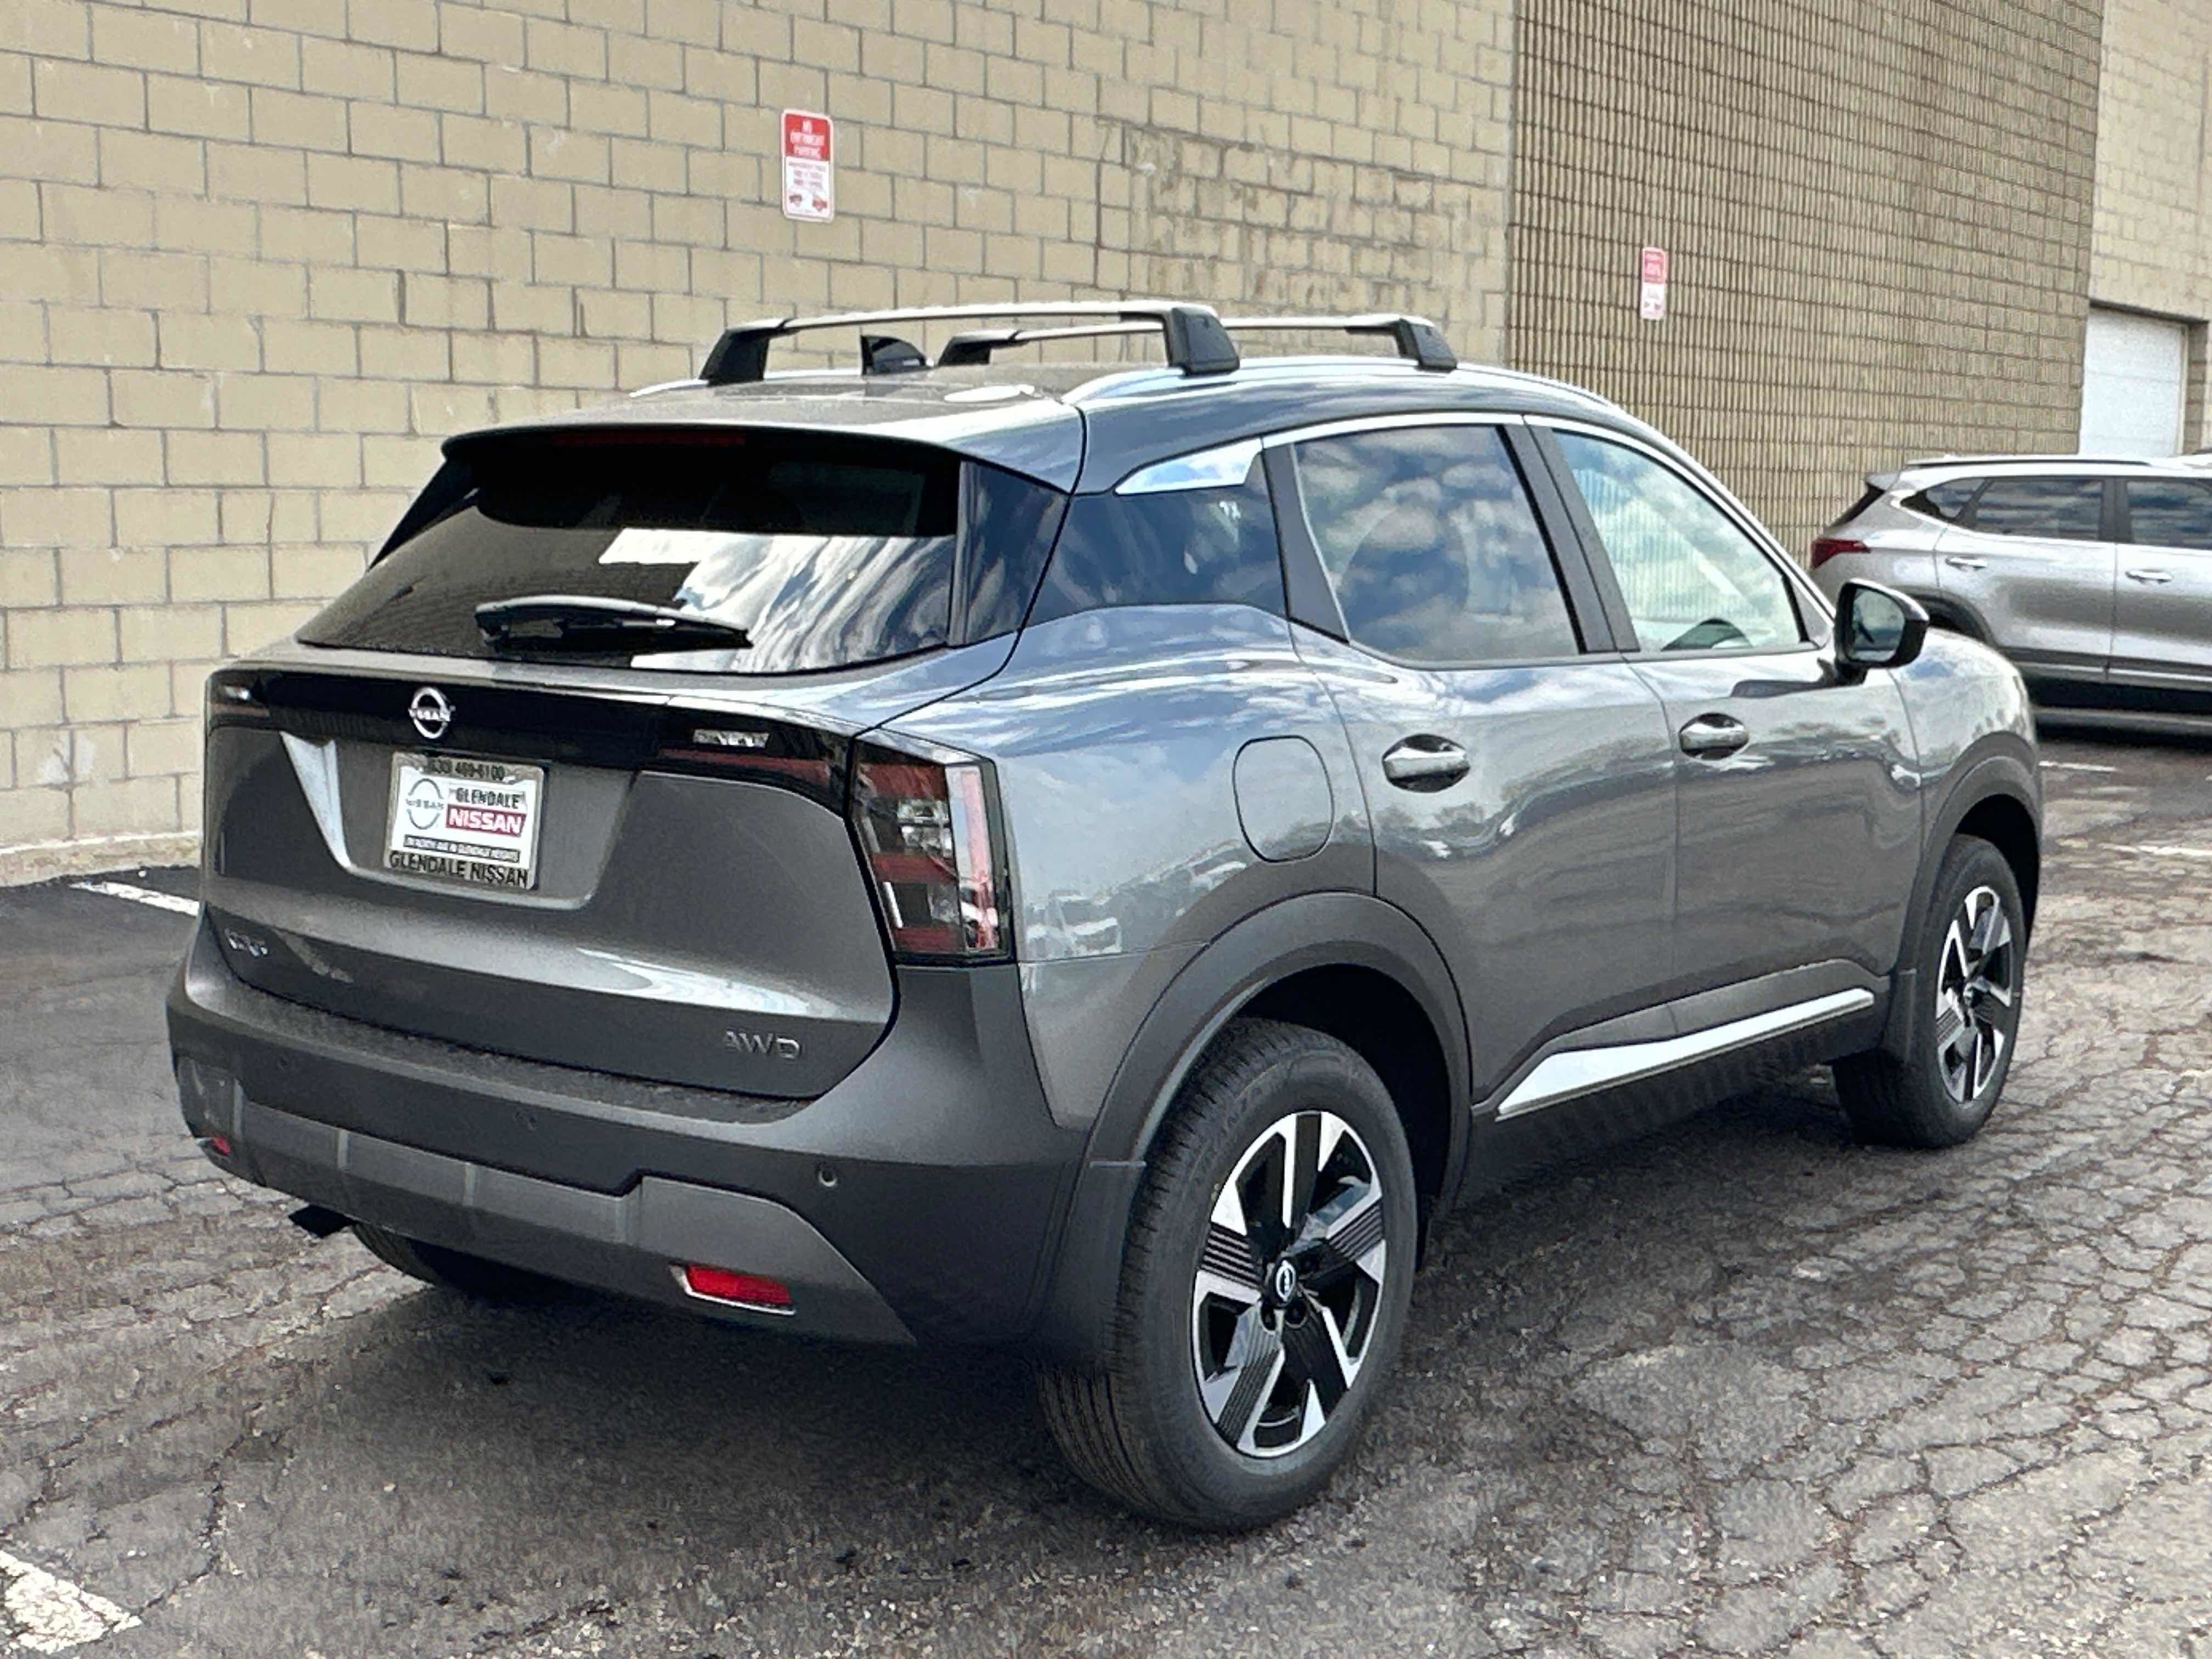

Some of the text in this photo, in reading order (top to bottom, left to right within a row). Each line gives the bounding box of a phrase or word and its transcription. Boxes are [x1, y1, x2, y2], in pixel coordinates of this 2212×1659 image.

[456, 787, 521, 809] GLENDALE
[449, 808, 522, 834] NISSAN
[389, 850, 528, 890] GLENDALE NISSAN
[722, 1028, 802, 1059] AWD
